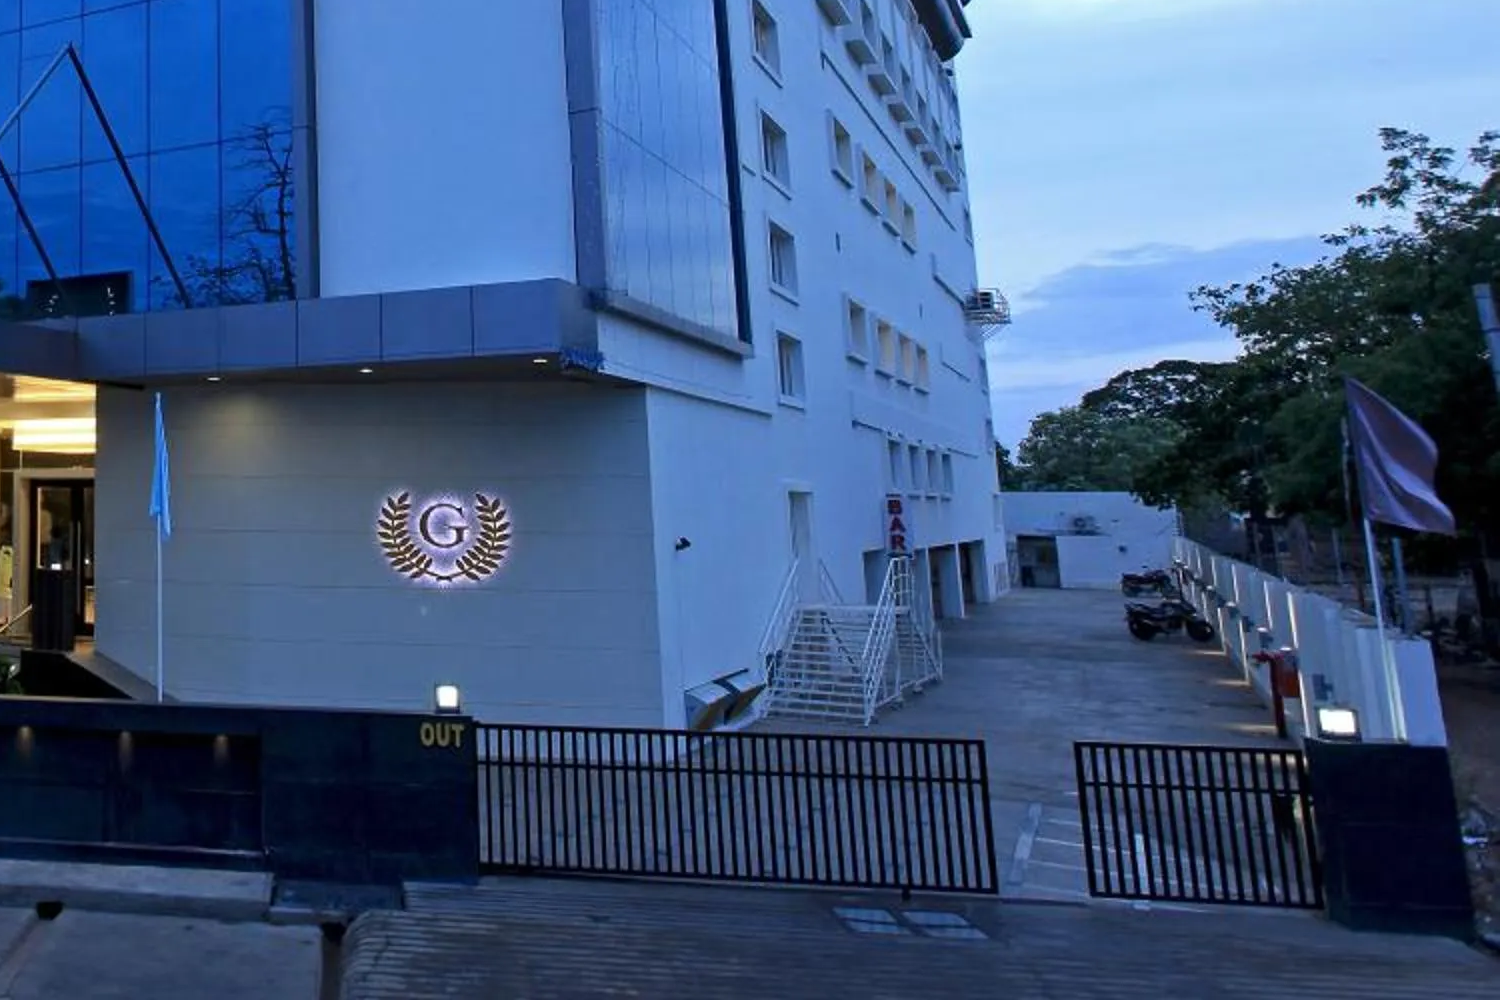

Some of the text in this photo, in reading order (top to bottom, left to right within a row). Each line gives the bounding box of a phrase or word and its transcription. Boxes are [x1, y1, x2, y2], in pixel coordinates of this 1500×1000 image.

[419, 503, 468, 548] G
[887, 500, 906, 551] BAR
[420, 722, 465, 748] OUT
